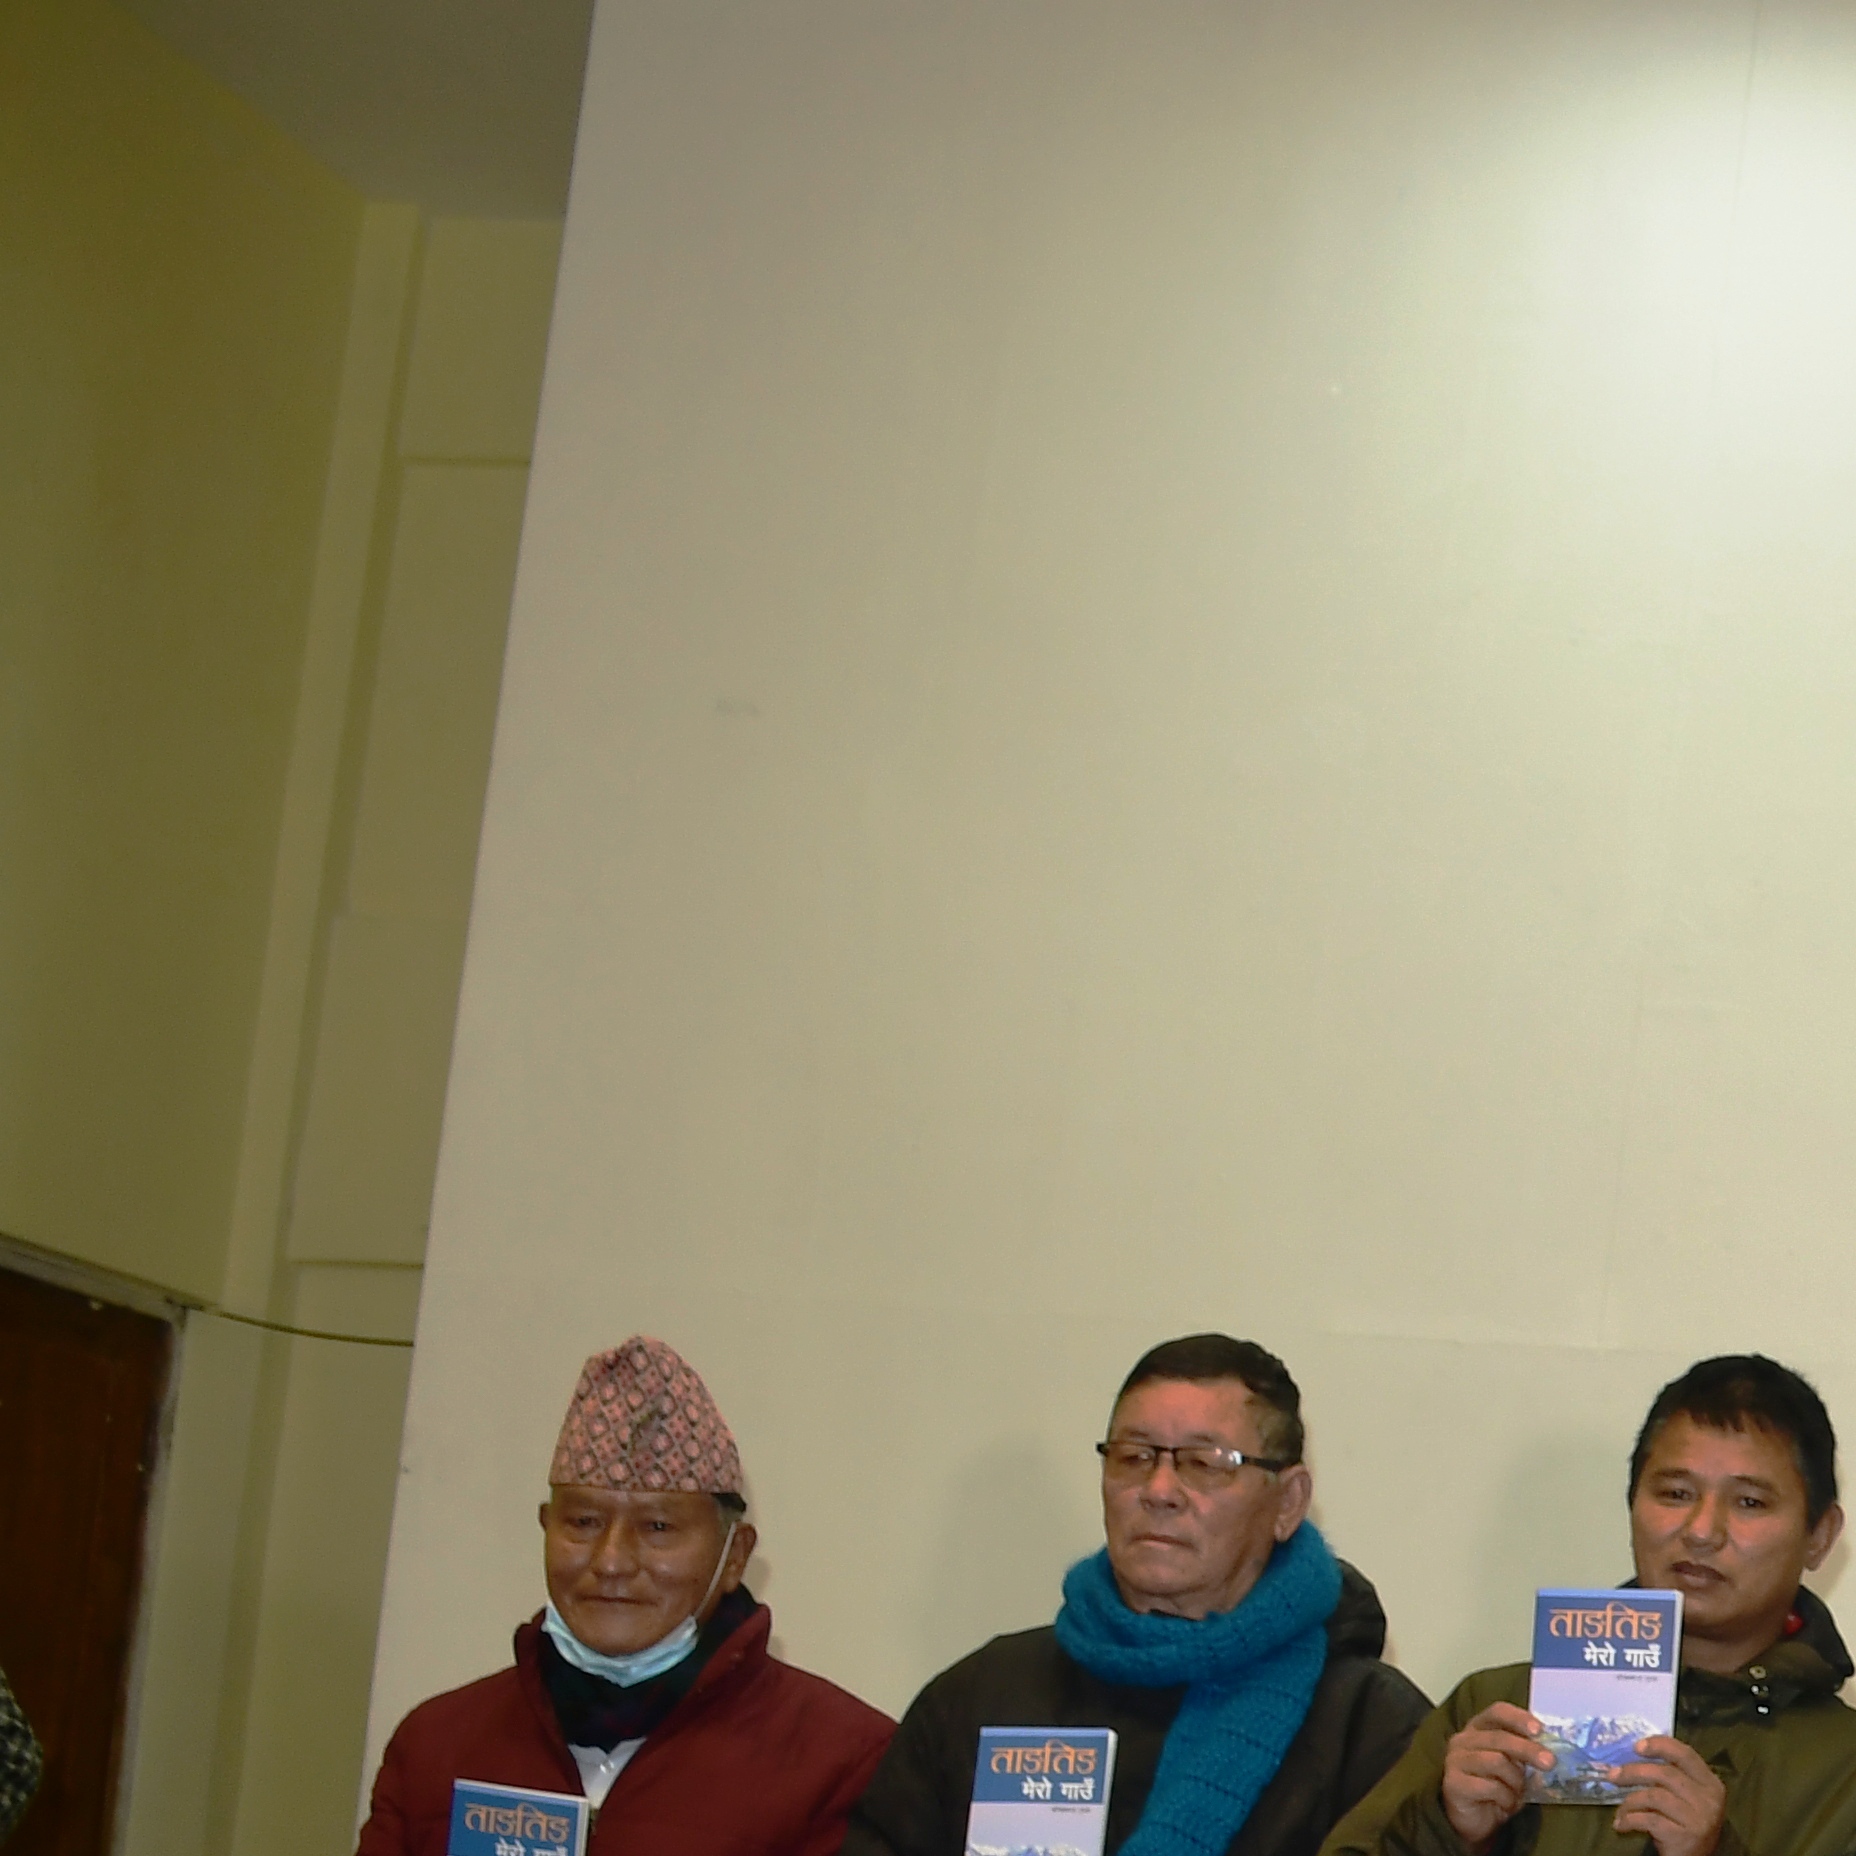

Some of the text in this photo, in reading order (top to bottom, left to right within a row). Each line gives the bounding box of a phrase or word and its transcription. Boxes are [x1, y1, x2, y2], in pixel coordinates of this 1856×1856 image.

[1548, 1600, 1663, 1641] ताङतिङ
[1583, 1640, 1662, 1668] मेरो गाउँ
[1021, 1776, 1053, 1800] मेरो
